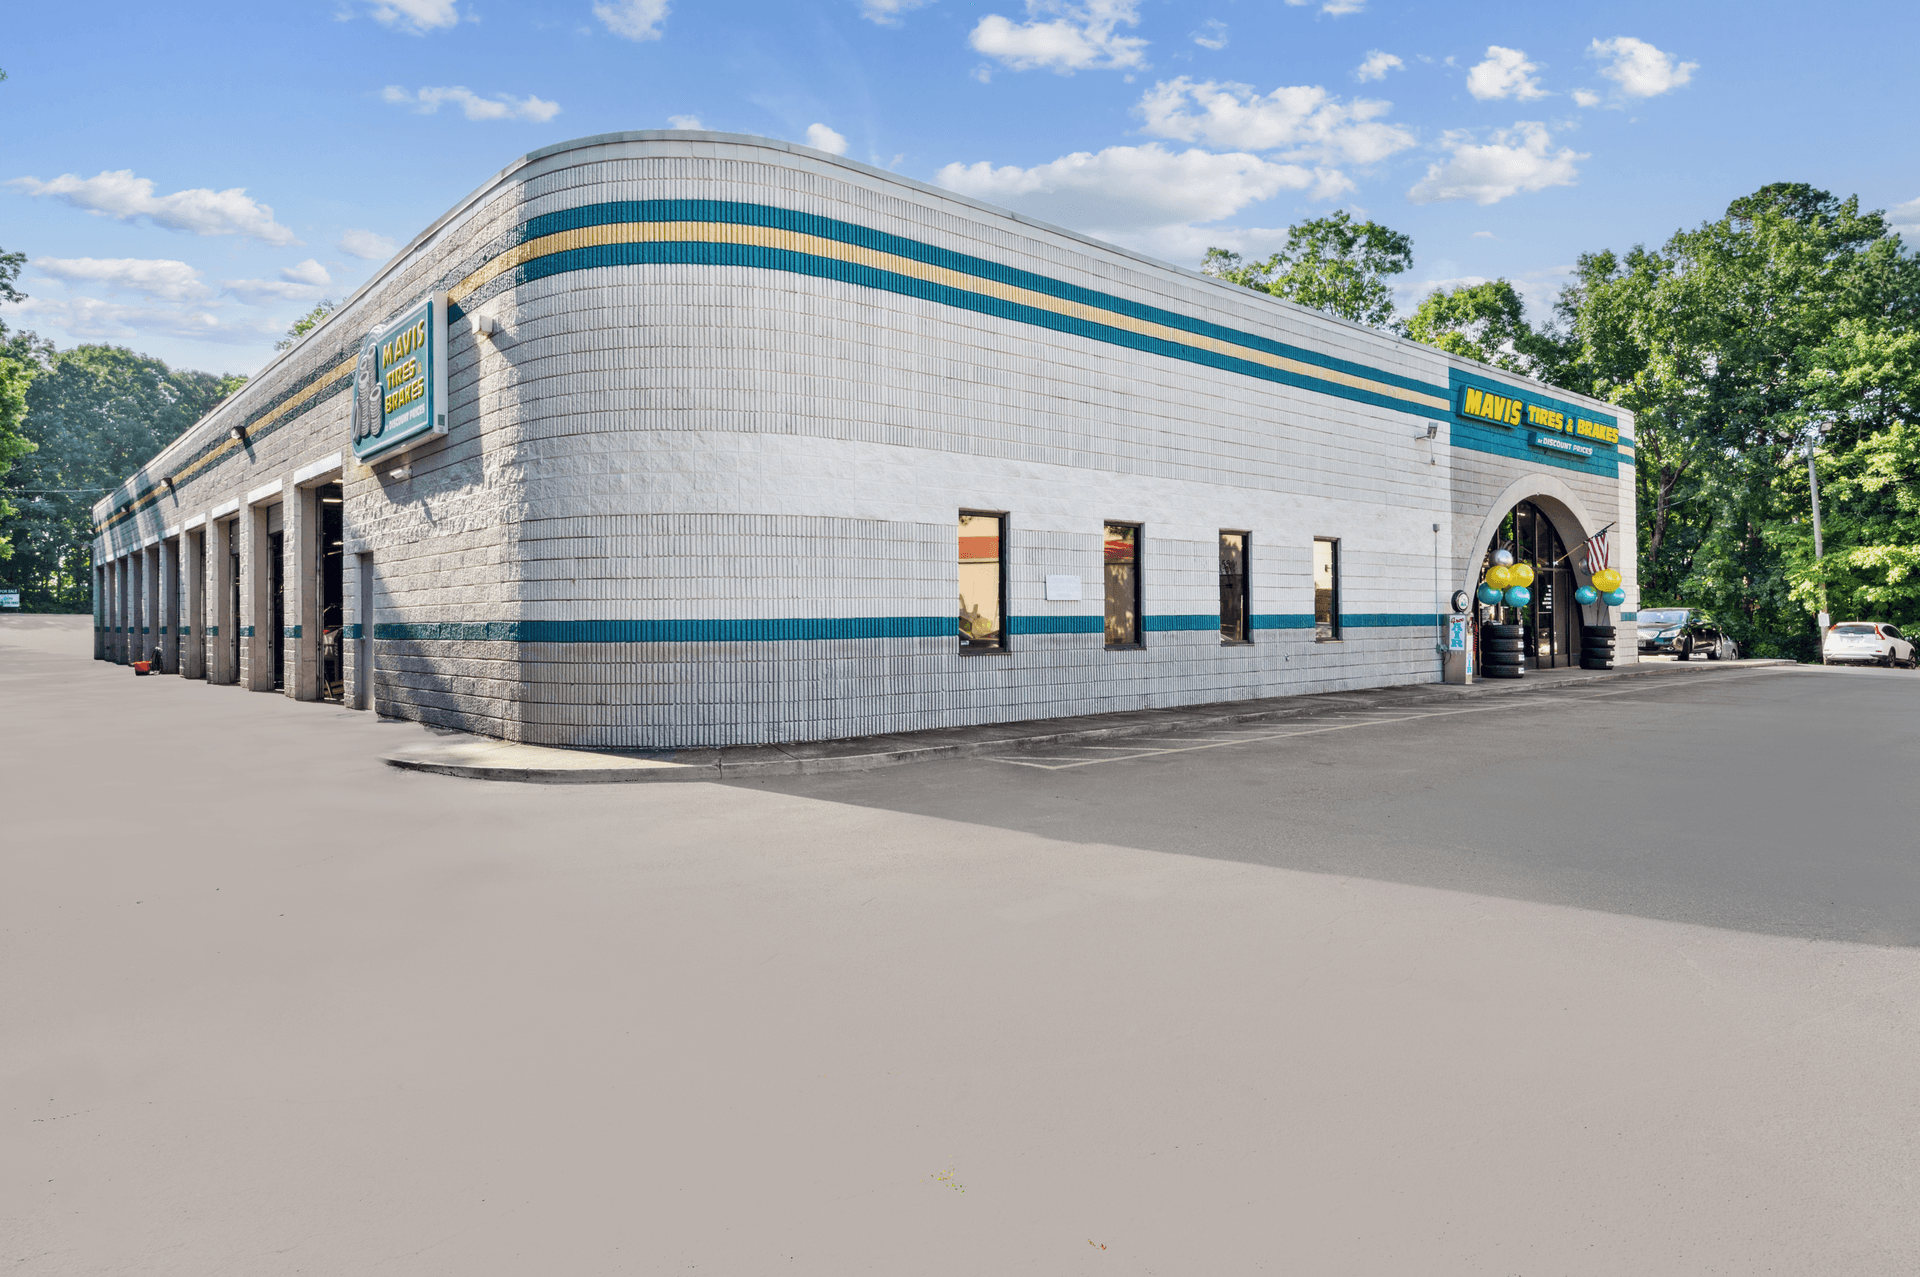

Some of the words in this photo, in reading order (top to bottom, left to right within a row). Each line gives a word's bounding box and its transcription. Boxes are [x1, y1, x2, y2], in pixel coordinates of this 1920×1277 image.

[383, 319, 425, 369] MAVIS
[386, 356, 417, 391] TIRES
[385, 376, 425, 414] BRAKES
[1464, 387, 1523, 426] MAVIS
[1528, 404, 1564, 431] TIRES
[1566, 417, 1574, 433] &
[1577, 418, 1619, 444] BRAKES
[1543, 437, 1572, 451] DISCOUNT
[1573, 445, 1593, 456] PRICES
[1451, 623, 1463, 647] AIR
